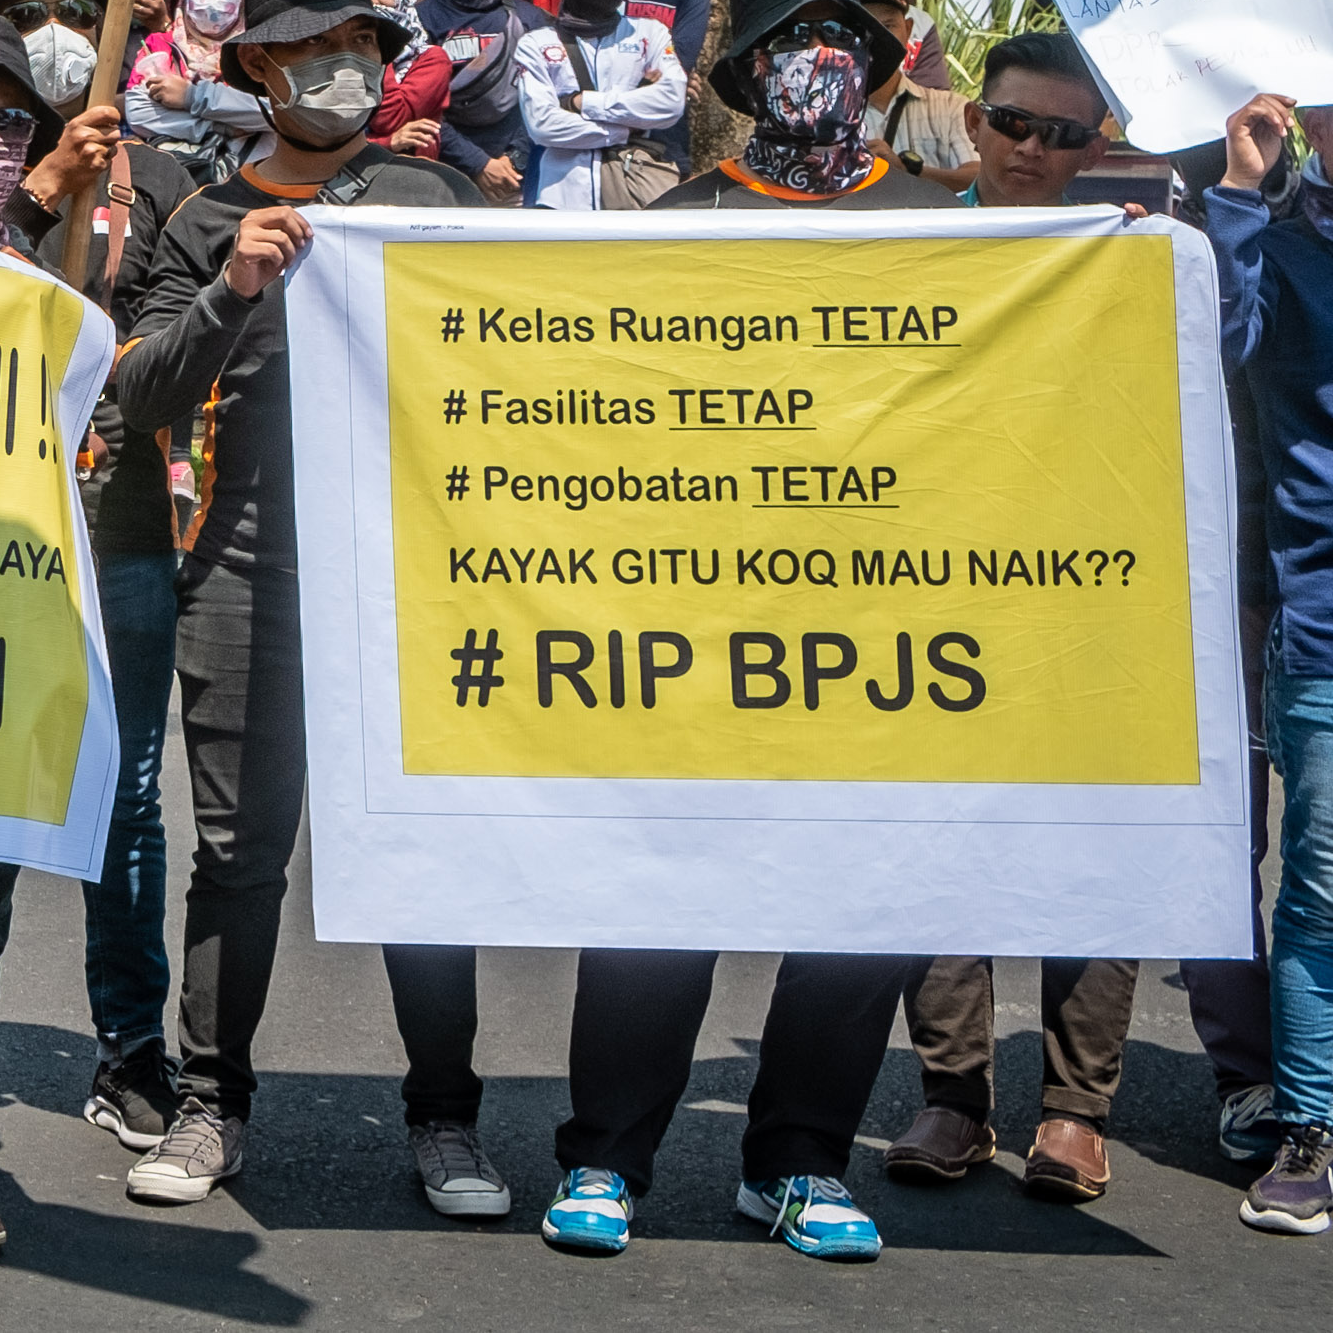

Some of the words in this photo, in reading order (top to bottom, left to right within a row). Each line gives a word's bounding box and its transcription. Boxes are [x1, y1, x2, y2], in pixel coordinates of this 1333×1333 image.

[479, 307, 595, 343] Kelas
[610, 307, 798, 352] Ruangan
[811, 305, 962, 348] TETAP
[481, 389, 656, 425] Fasilitas
[668, 388, 817, 431] TETAP
[484, 466, 738, 511] Pengobatan
[751, 466, 900, 509] TETAP
[449, 547, 598, 584] KAYAK
[612, 548, 720, 585] GITU
[737, 548, 839, 588] KOQ
[851, 549, 951, 586] MAU
[968, 549, 1136, 587] NAIK??
[536, 629, 693, 709] RIP
[729, 631, 987, 713] BPJS
